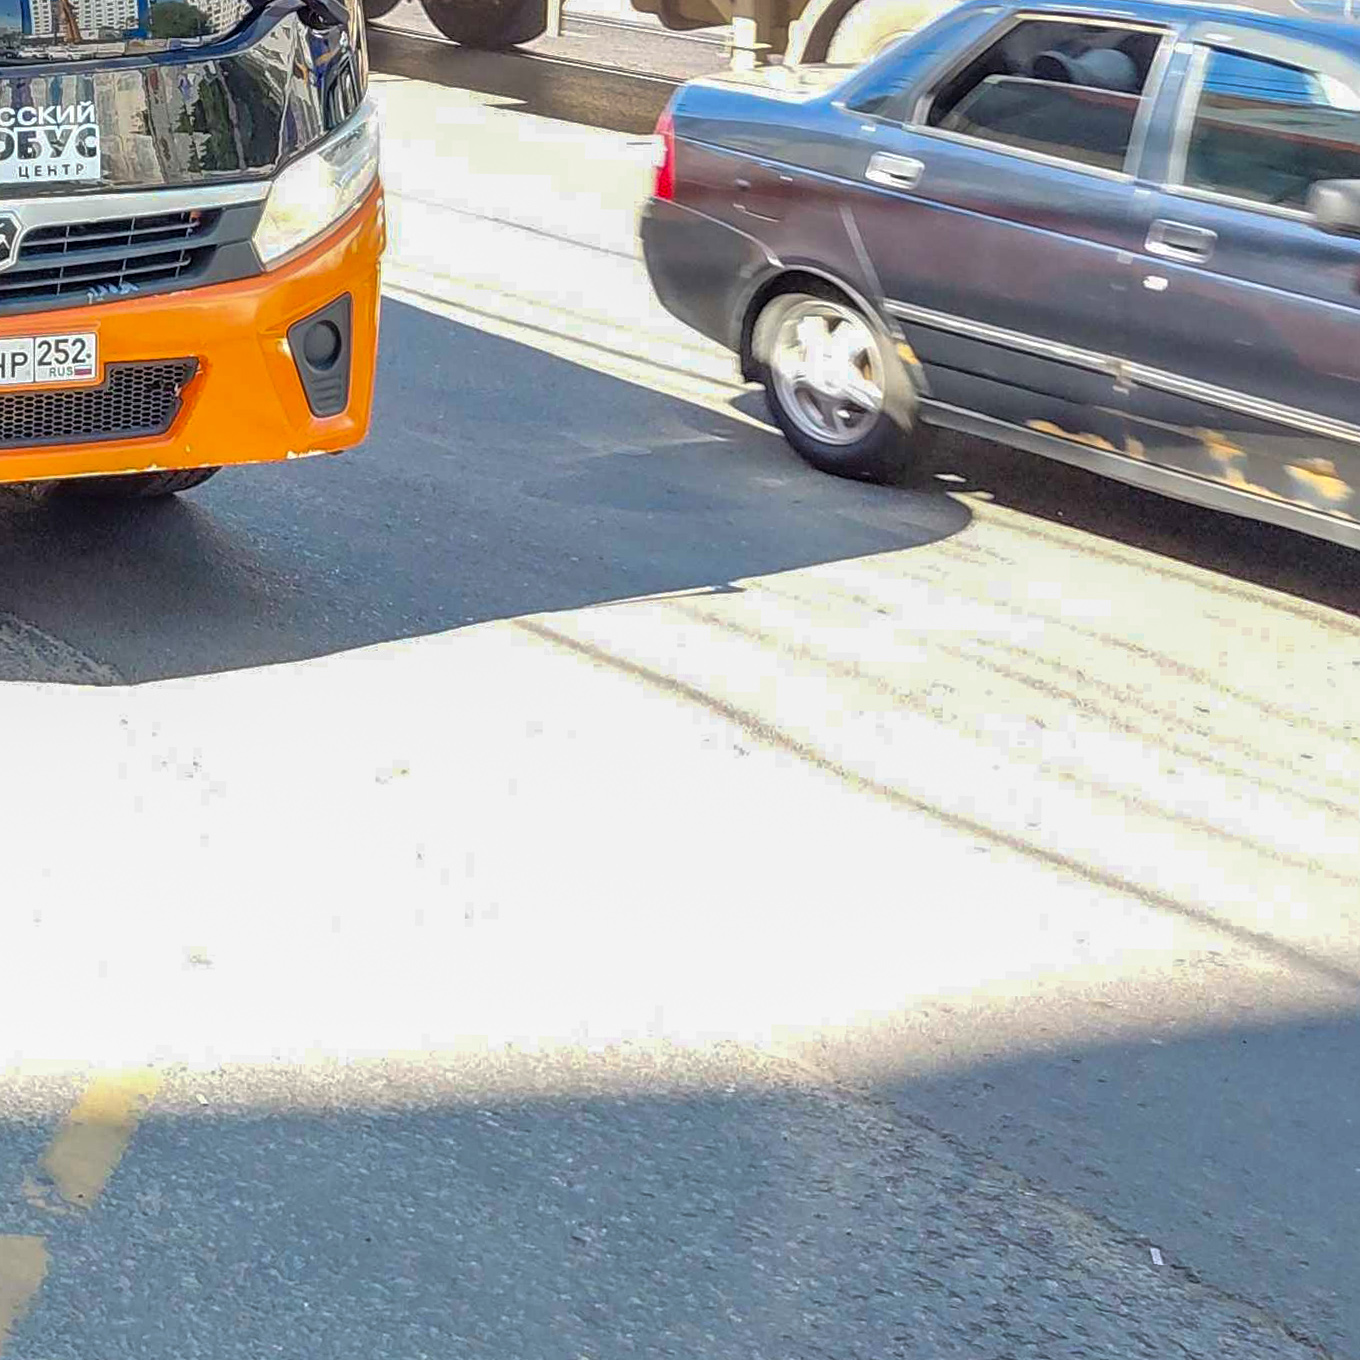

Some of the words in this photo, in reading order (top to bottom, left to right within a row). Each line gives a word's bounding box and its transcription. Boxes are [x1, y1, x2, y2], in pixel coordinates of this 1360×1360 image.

[18, 163, 87, 179] ЦЕНТР
[37, 337, 86, 366] 252
[49, 365, 74, 378] RUS
